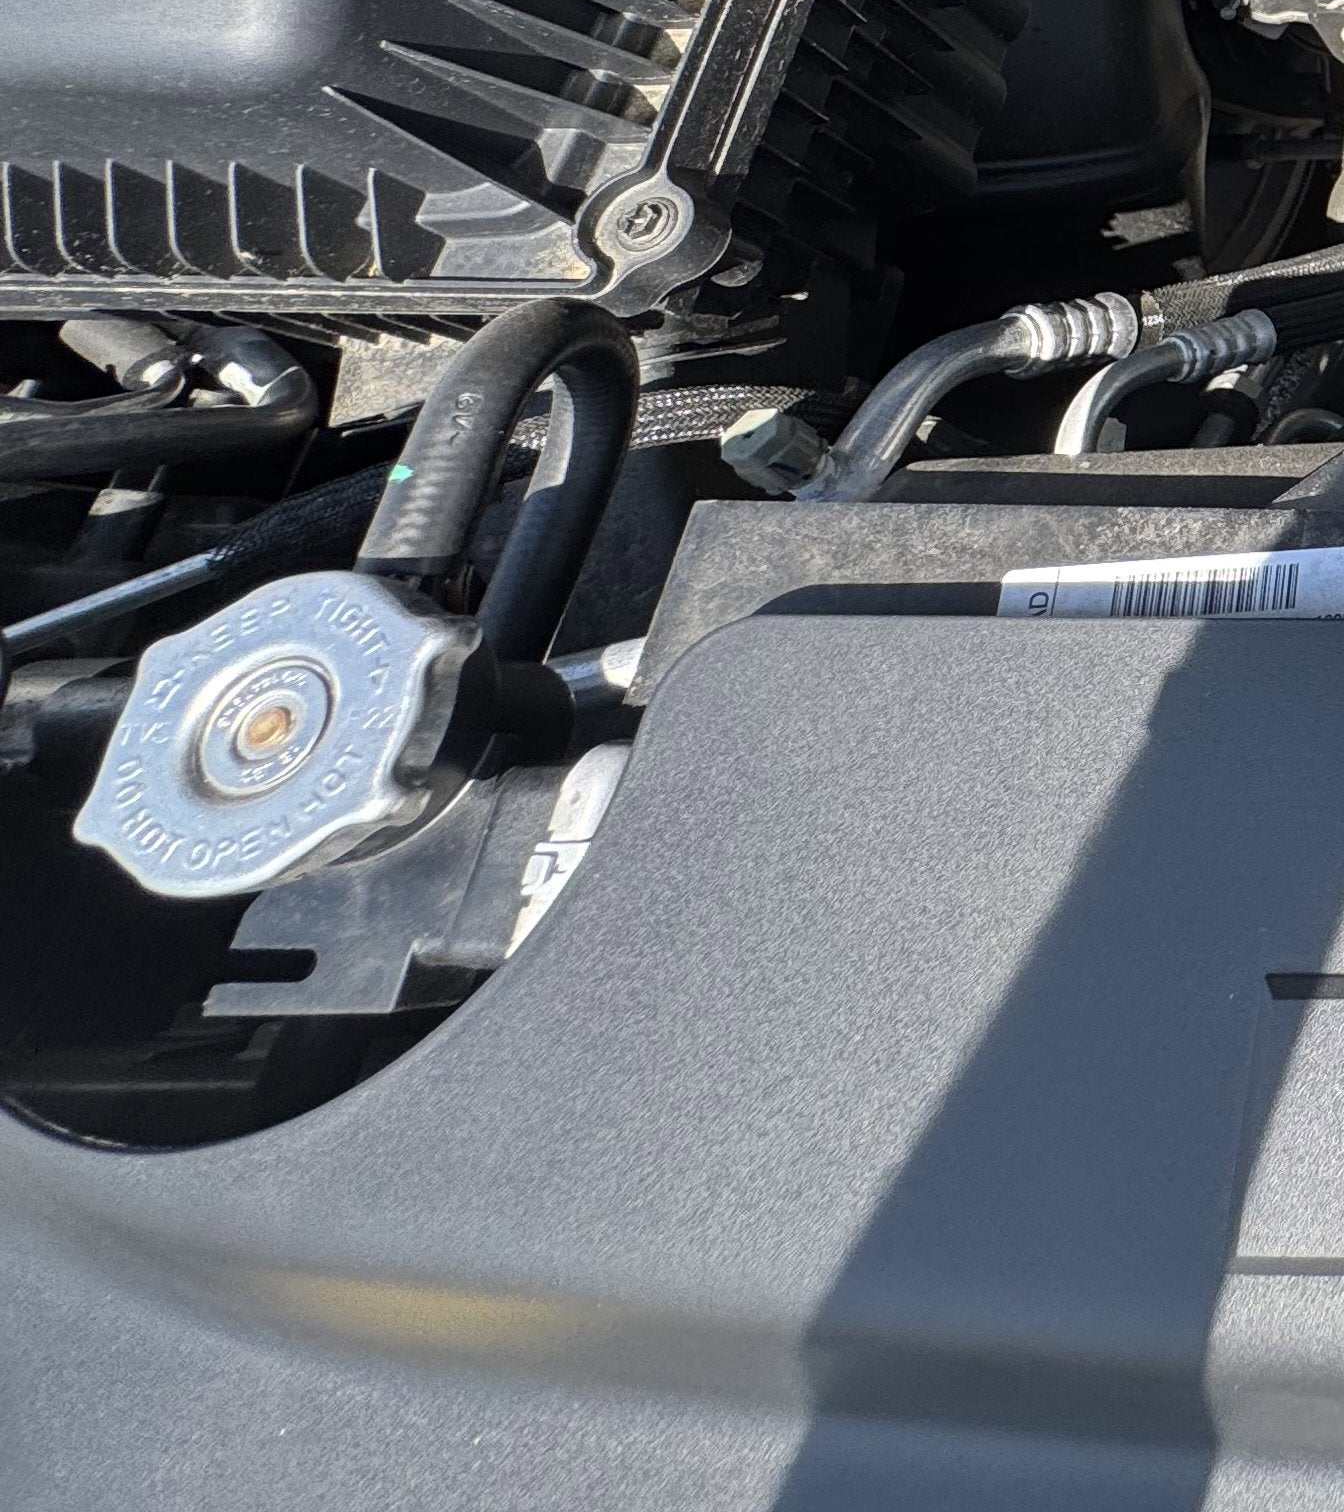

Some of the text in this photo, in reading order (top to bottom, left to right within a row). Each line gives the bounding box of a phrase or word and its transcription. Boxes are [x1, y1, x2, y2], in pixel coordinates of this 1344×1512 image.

[314, 589, 391, 656] TIGHT
[114, 756, 146, 811] DO
[300, 743, 364, 823] HOT
[120, 807, 188, 865] NOT
[189, 814, 293, 872] OPEN
